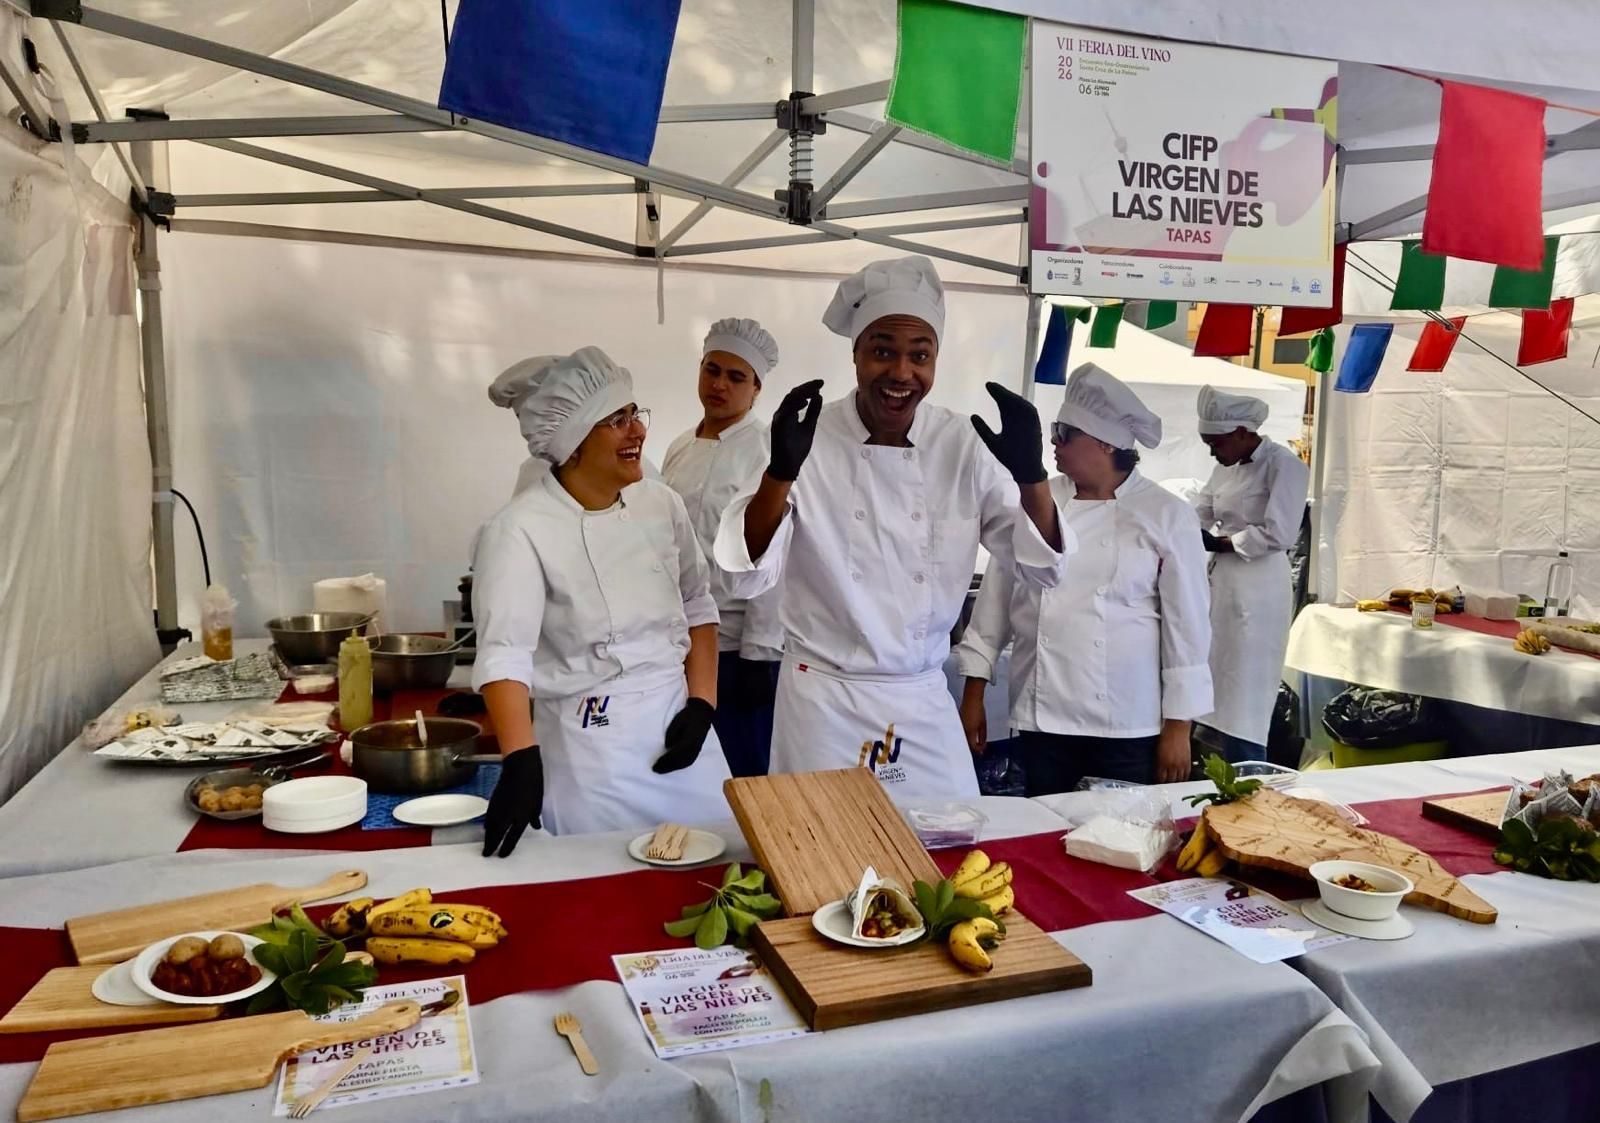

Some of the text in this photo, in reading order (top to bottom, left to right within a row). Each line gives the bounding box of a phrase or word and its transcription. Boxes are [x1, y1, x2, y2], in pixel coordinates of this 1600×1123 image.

[1056, 36, 1171, 63] VII FERIA DEL VINO
[1058, 55, 1073, 68] 20
[1058, 67, 1073, 80] 26
[1078, 83, 1092, 95] 06
[1162, 132, 1218, 161] CIFP
[1117, 160, 1259, 197] VIRGEN DE
[1112, 191, 1263, 229] LAS NIEVES
[1166, 227, 1212, 244] TAPAS
[413, 986, 447, 996] VINO
[660, 985, 765, 1005] VIRGEN DE
[688, 983, 729, 994] CIFP
[662, 992, 772, 1015] LAS NIEVES
[704, 1012, 746, 1022] TAPAS
[316, 1034, 404, 1055] VIRGEN
[415, 1029, 442, 1040] DE
[311, 1050, 354, 1064] LAS
[357, 1057, 405, 1070] TAPAS
[341, 1071, 380, 1081] ARNE
